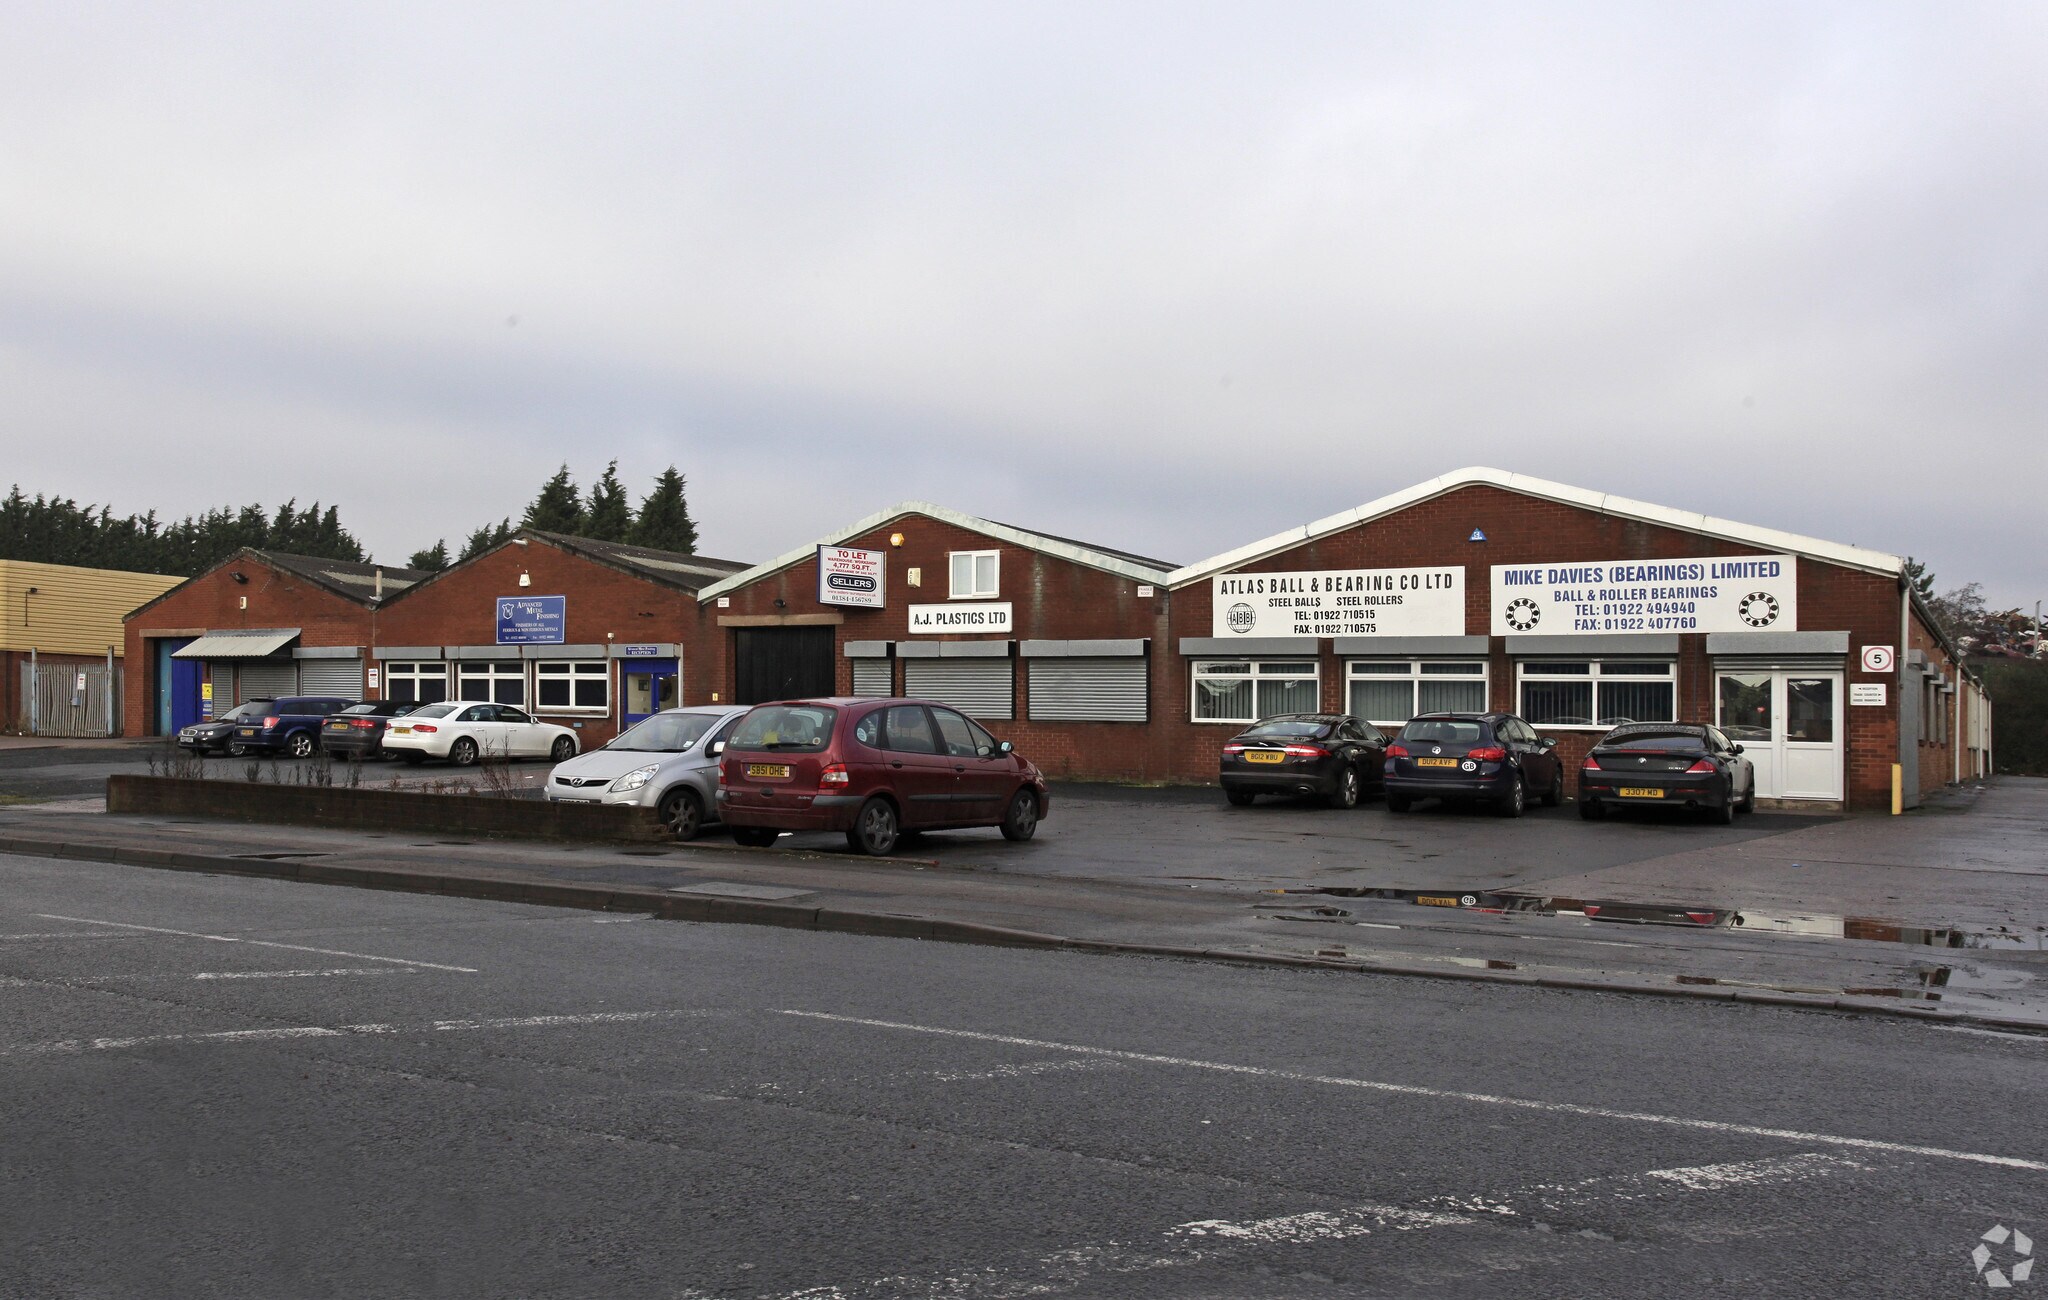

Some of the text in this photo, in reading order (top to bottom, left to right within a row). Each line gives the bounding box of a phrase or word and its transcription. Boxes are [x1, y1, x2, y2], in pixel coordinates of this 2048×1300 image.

[837, 550, 868, 560] TO LET
[1504, 560, 1780, 586] MIKE DAVIES (BEARINGS) LIMITED
[832, 577, 872, 588] SELLERS
[1220, 573, 1453, 595] ATLAS BALL & BEARING CO LTD
[1554, 585, 1718, 602] BALL & ROLLER BEARINGS
[1268, 597, 1321, 608] STEEL BALLS
[1336, 595, 1403, 607] STEEL ROLLERS
[1574, 601, 1696, 616] TEL: 01922 494940
[914, 611, 1006, 625] A.J. PLASTICS LTD
[1294, 609, 1376, 621] TEL: 01922 710515
[1293, 623, 1377, 634] FAX: 01922 710575
[1574, 616, 1697, 631] FAX: 01922 407760
[1873, 654, 1882, 664] 5
[751, 765, 768, 775] SB51
[1625, 788, 1646, 796] 3307
